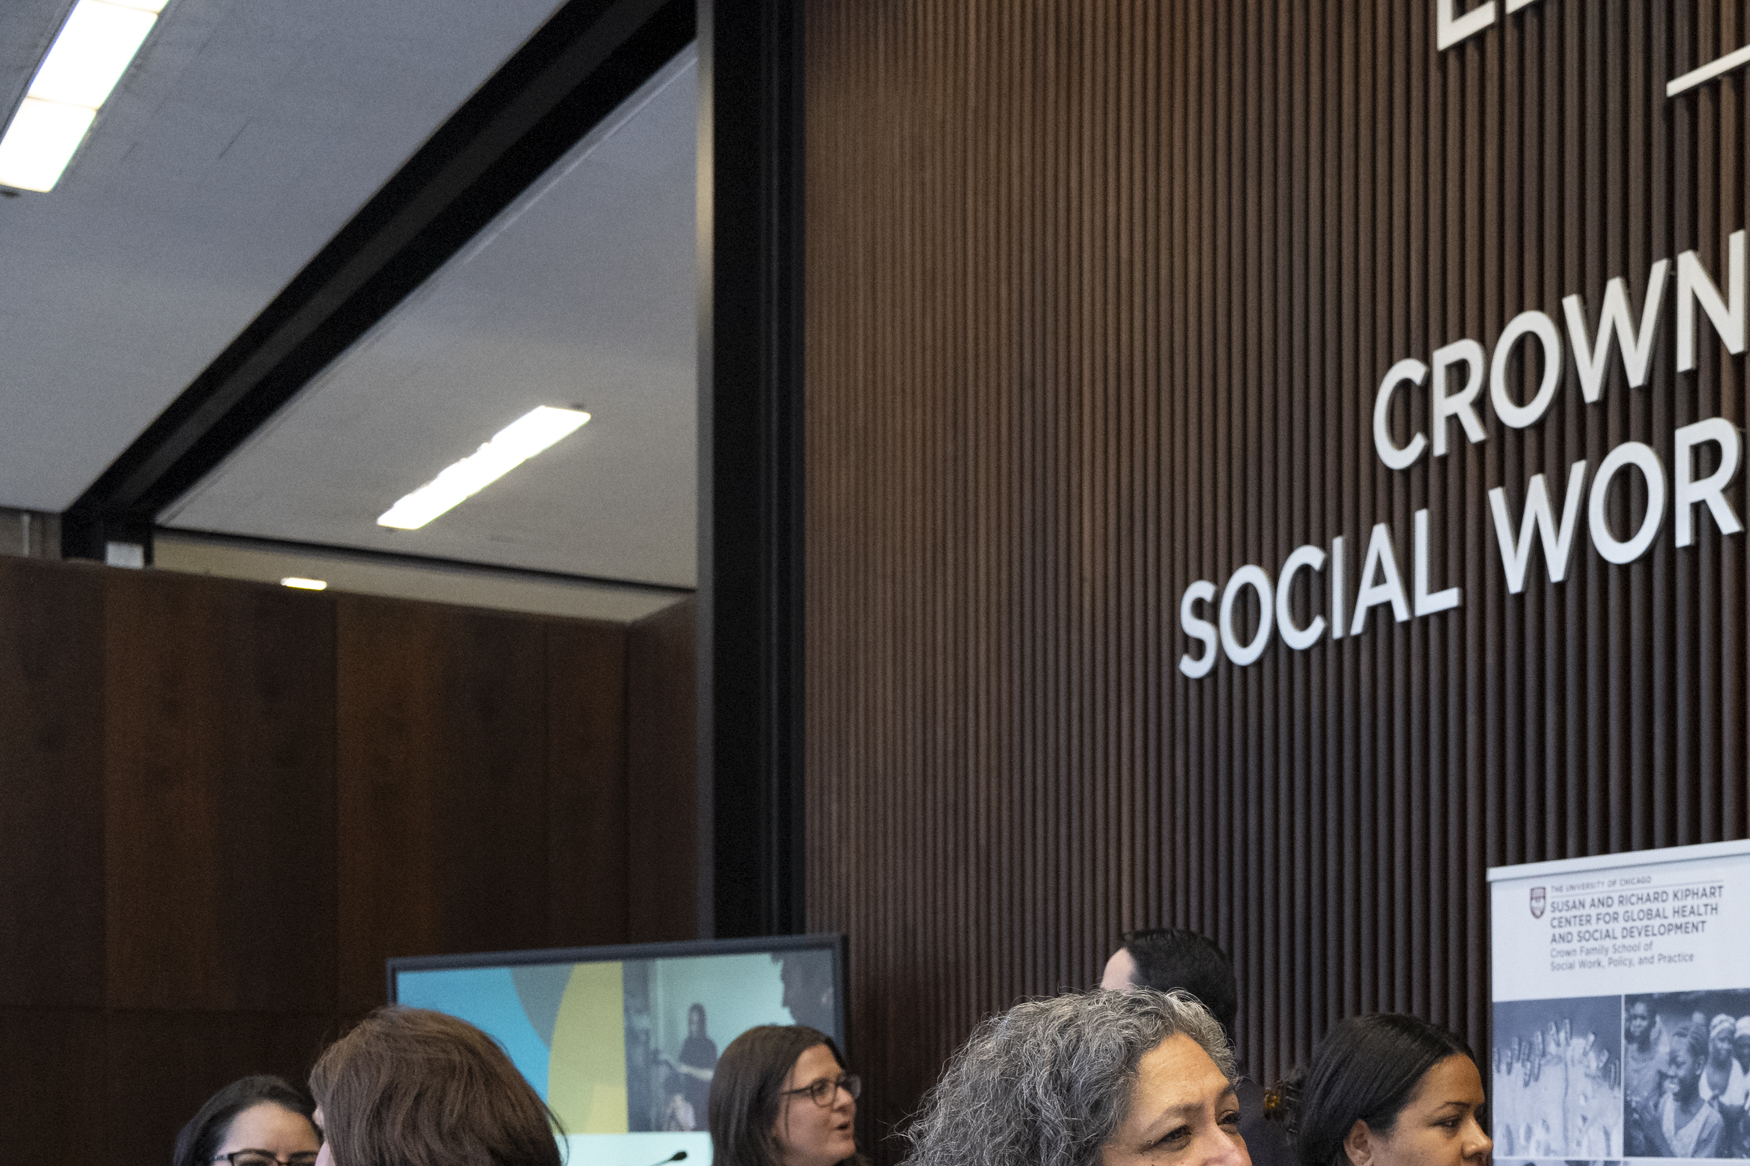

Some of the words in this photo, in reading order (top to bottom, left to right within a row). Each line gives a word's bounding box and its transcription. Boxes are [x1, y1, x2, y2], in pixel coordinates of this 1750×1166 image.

[1373, 231, 1747, 470] CROWN
[1179, 508, 1460, 679] SOCIAL
[1551, 885, 1563, 893] THE
[1566, 881, 1604, 892] UNIVERSITY
[1607, 879, 1617, 888] OF
[1619, 876, 1652, 887] CHICAGO
[1550, 898, 1586, 913] SUSAN
[1589, 896, 1614, 909] AND
[1618, 891, 1669, 906] RICHARD
[1672, 885, 1724, 900] KIPHART
[1550, 914, 1592, 929] CENTER
[1596, 911, 1619, 924] FOR
[1622, 907, 1668, 923] GLOBAL
[1672, 903, 1719, 918] HEALTH
[1550, 932, 1573, 944] AND
[1577, 928, 1618, 943] SOCIAL
[1621, 920, 1706, 939] DEVELOPMENT
[1550, 947, 1577, 959] Crown
[1580, 944, 1609, 957] Family
[1612, 942, 1641, 954] School
[1643, 941, 1653, 951] of
[1550, 960, 1575, 972] Social
[1578, 958, 1605, 970] Work,
[1607, 955, 1635, 968] Policy,
[1638, 954, 1655, 966] and
[1657, 952, 1694, 964] Practice
